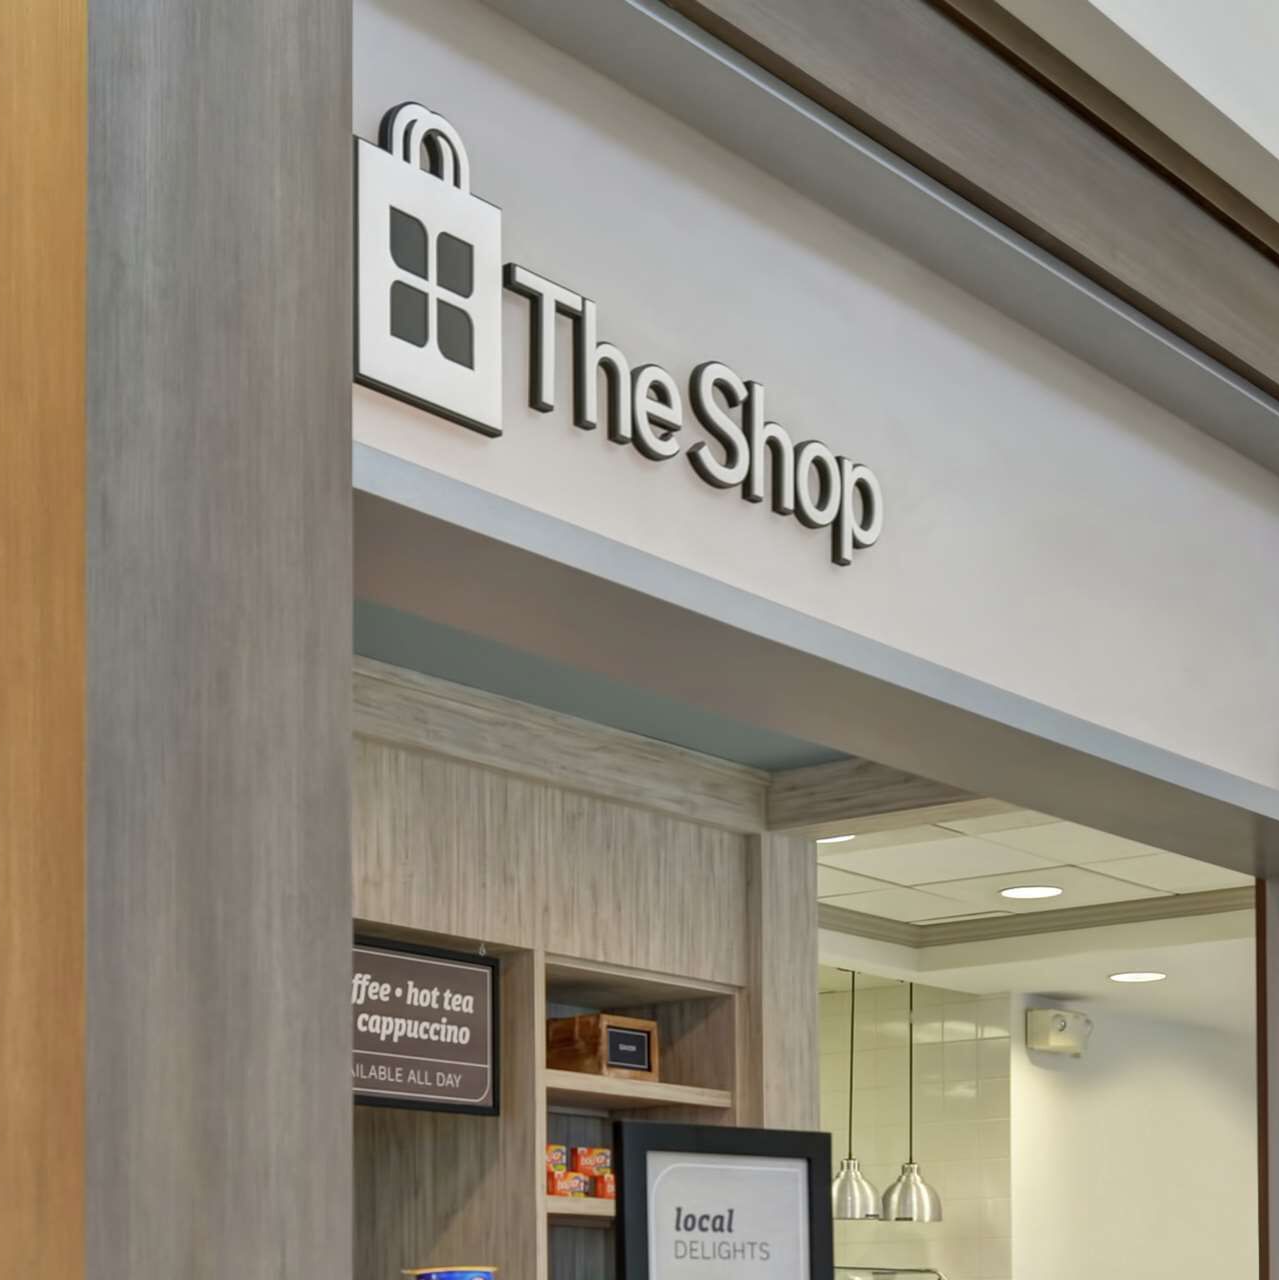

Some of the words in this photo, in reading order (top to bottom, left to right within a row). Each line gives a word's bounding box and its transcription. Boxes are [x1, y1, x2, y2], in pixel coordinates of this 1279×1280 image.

[503, 262, 683, 461] The
[687, 360, 885, 566] Shop
[406, 980, 440, 1009] hot
[443, 989, 474, 1014] tea
[356, 1012, 471, 1045] cappuccino
[407, 1069, 432, 1086] ALL
[435, 1071, 462, 1088] DAY
[675, 1206, 735, 1234] local
[674, 1239, 771, 1261] DELIGHTS
